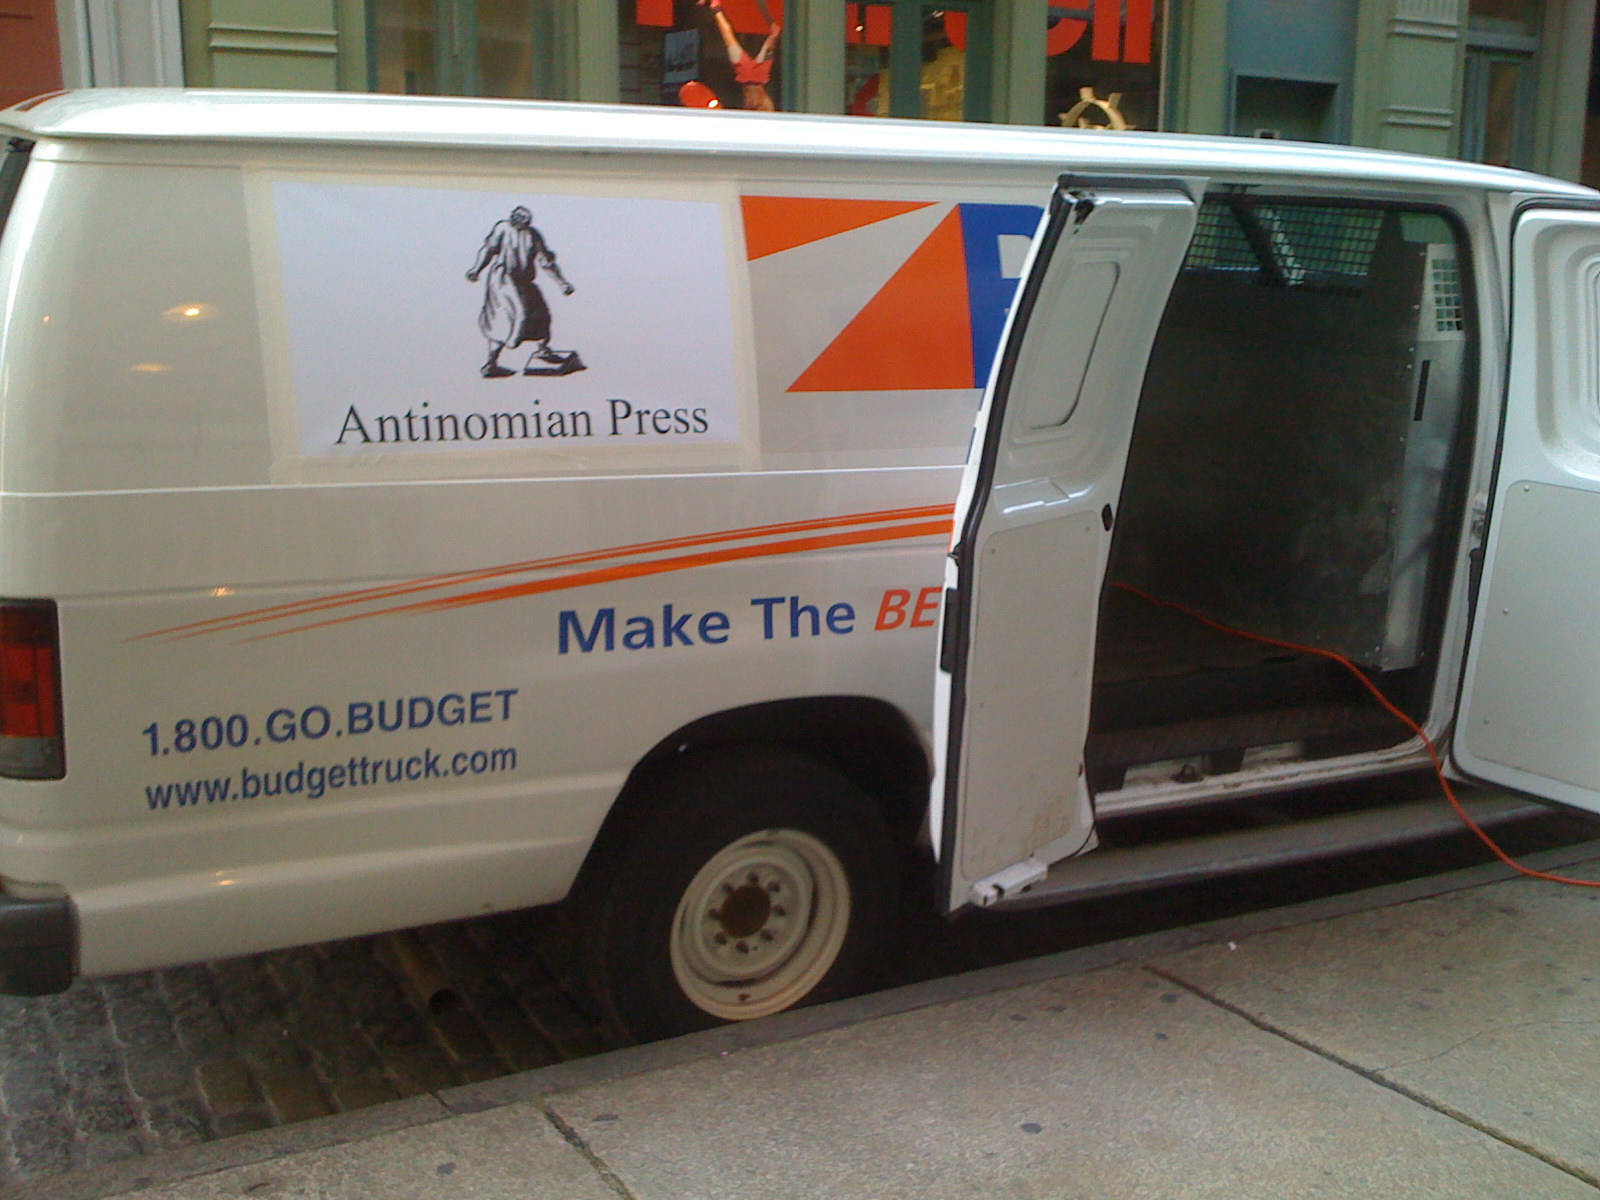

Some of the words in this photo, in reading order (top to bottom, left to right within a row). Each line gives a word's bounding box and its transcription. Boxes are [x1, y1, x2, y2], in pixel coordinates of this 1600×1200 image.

[334, 399, 593, 445] Antinomian
[606, 398, 709, 437] Press
[558, 604, 731, 654] Make
[750, 596, 856, 639] The
[142, 688, 519, 756] 1.800.GO.BUDGET
[145, 747, 518, 810] www.budgettruck.com
